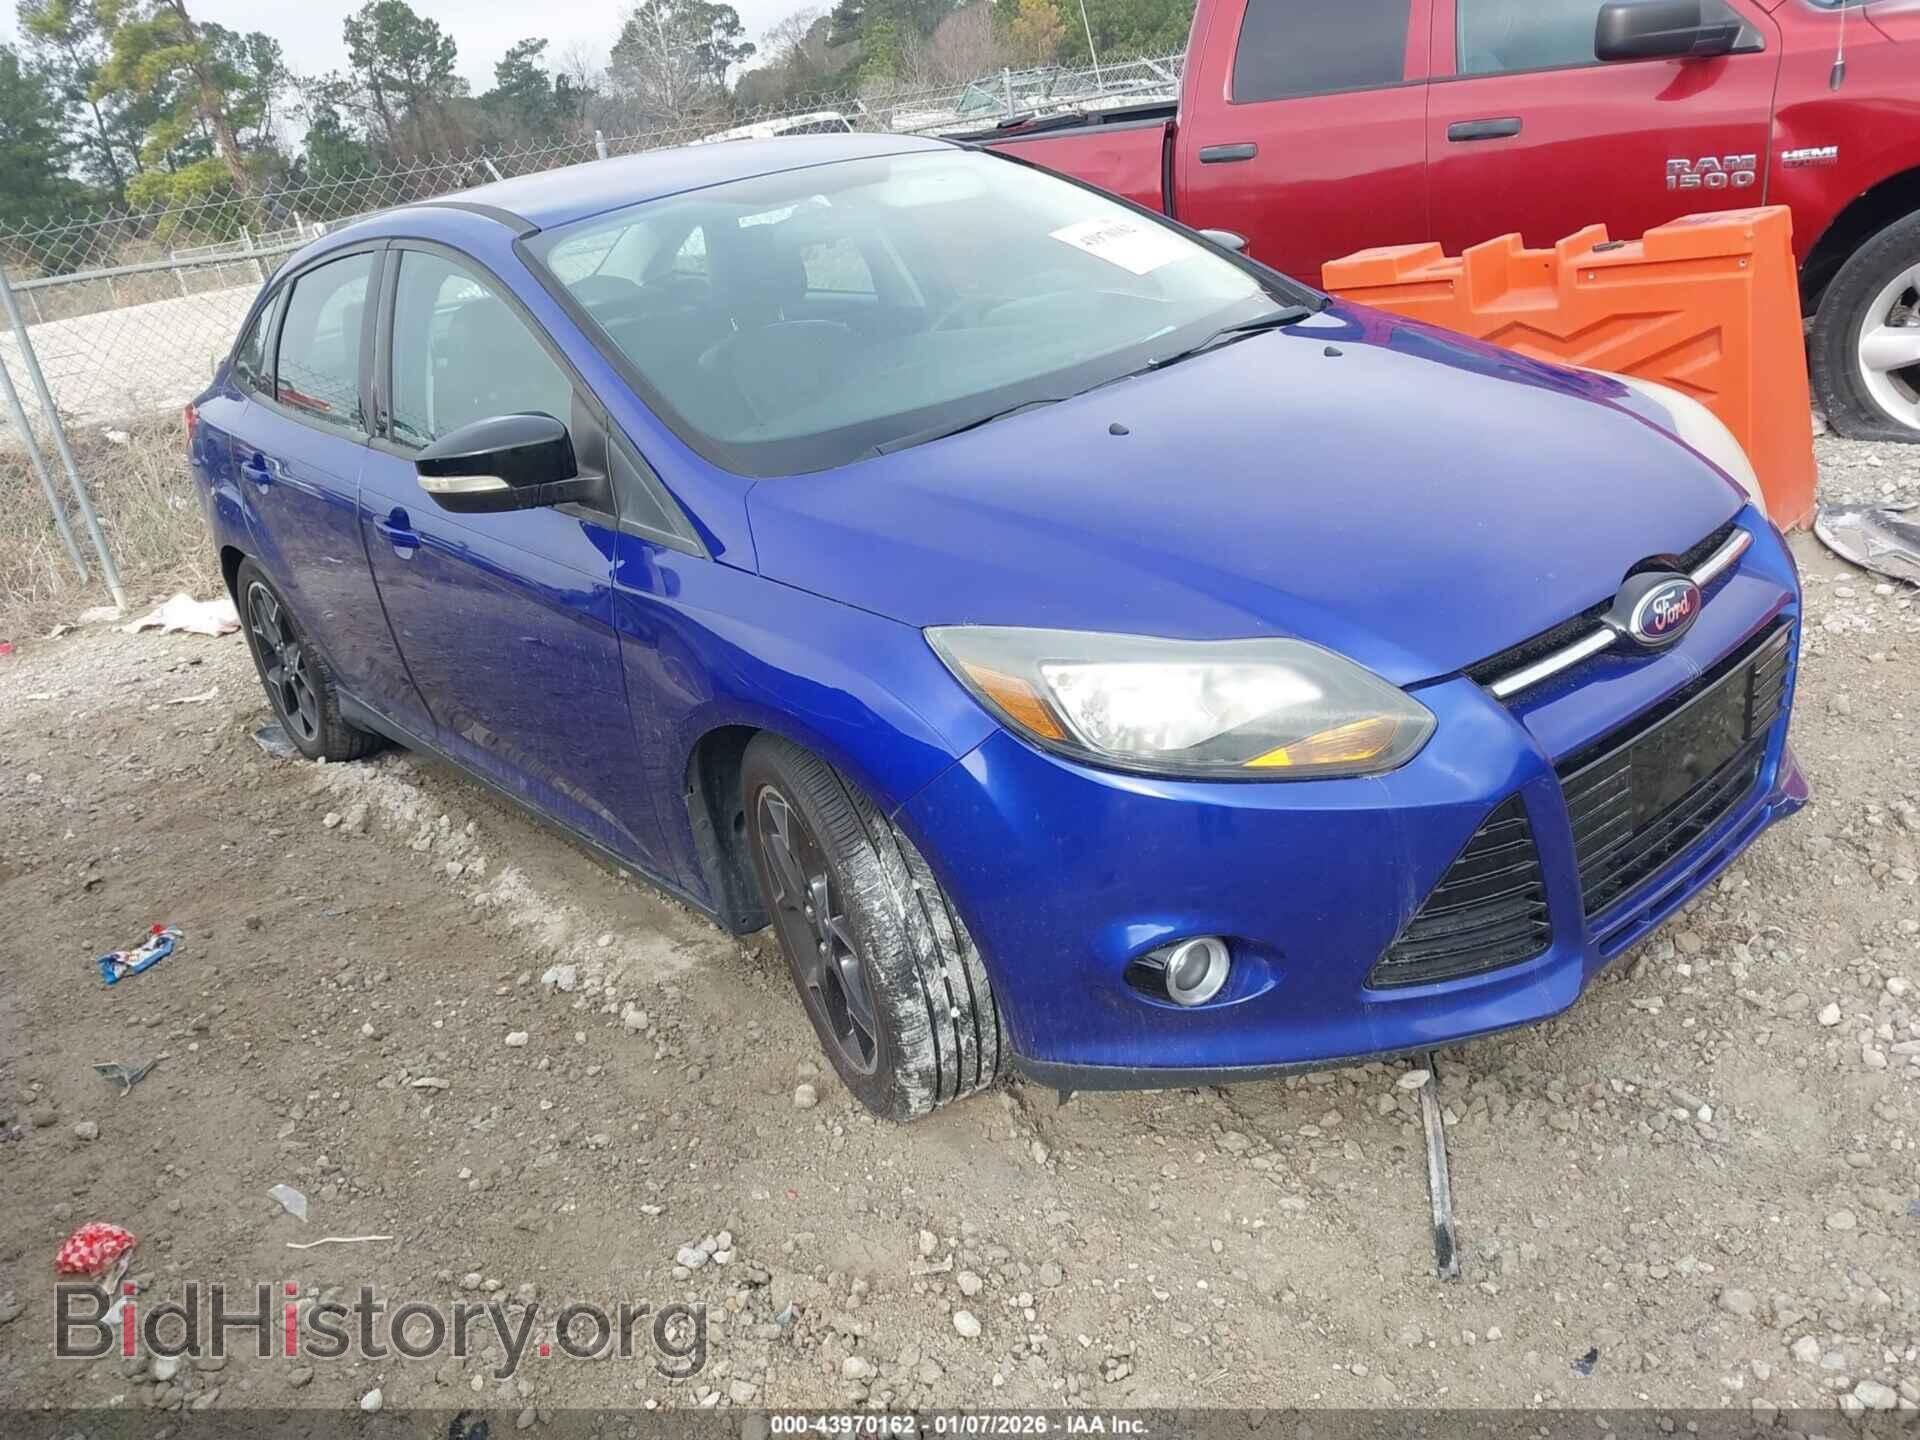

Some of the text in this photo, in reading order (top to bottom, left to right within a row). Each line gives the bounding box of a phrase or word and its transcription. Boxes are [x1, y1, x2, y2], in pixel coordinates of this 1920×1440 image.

[1781, 146, 1838, 160] HEMI
[1666, 154, 1756, 174] RAM
[1666, 171, 1755, 190] 1500
[1653, 590, 1690, 630] Ford
